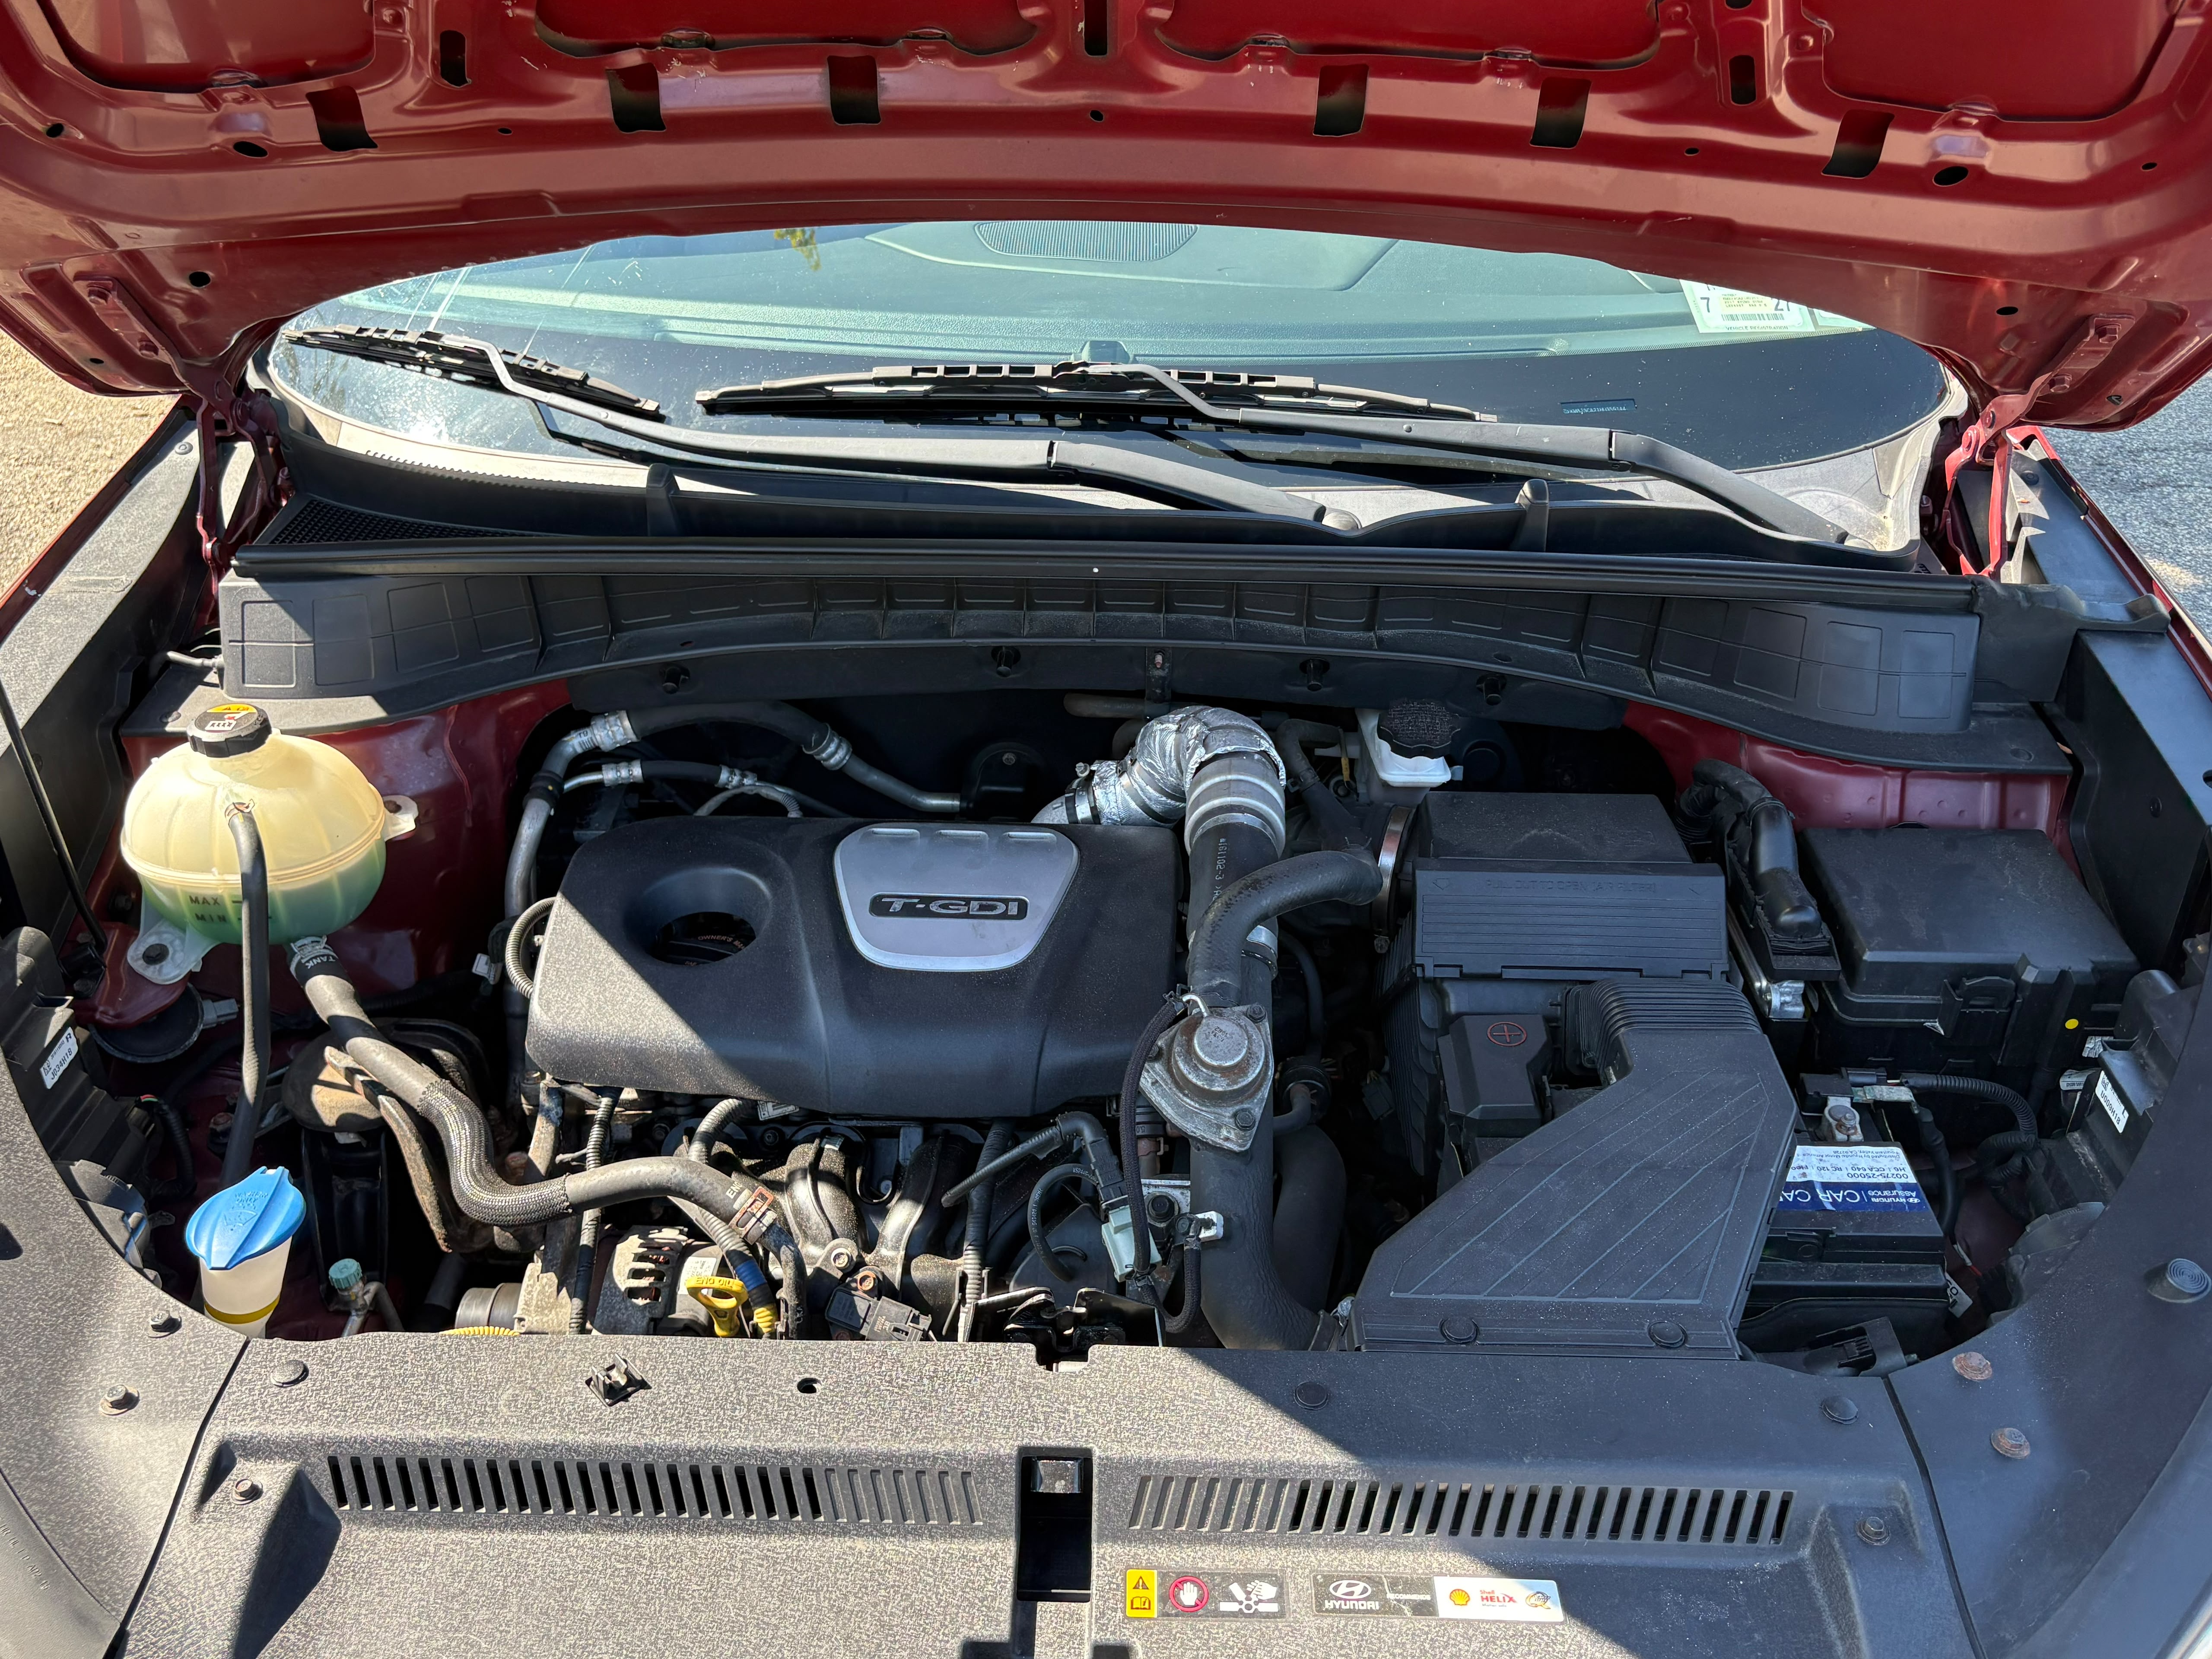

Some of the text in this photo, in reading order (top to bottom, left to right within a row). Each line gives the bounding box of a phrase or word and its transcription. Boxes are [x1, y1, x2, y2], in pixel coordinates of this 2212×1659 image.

[1700, 297, 1710, 313] 7
[189, 895, 220, 906] MAX
[881, 898, 1018, 915] T-GDI
[195, 913, 227, 922] MIN
[305, 956, 336, 969] TANK
[66, 1032, 72, 1043] R
[726, 1180, 743, 1200] ENG
[1780, 1189, 1860, 1203] CAR CA
[718, 1278, 734, 1288] OIL
[1480, 1593, 1518, 1603] HELIX
[1324, 1599, 1379, 1611] HYUNDAI
